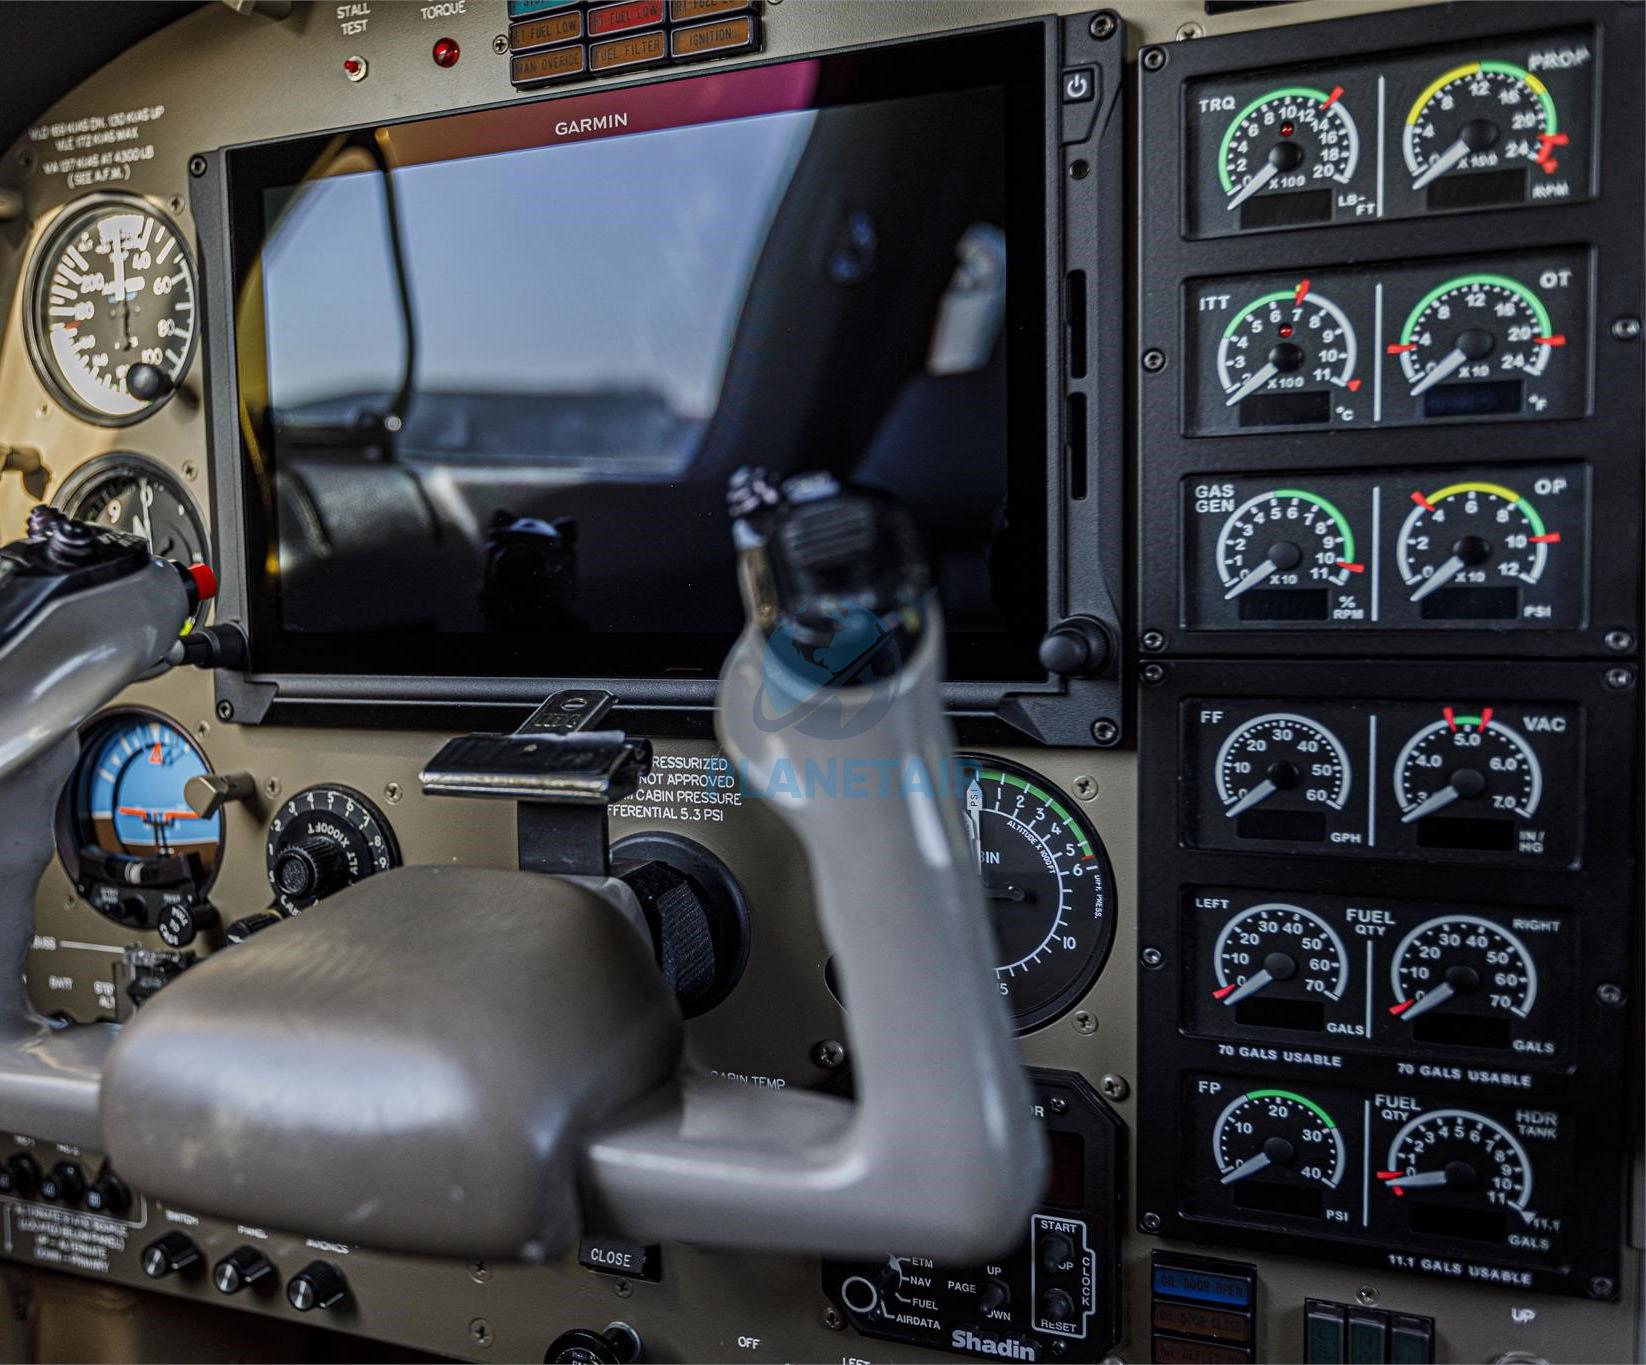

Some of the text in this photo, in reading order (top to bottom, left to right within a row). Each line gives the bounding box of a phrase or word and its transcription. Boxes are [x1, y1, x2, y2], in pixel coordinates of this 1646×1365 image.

[336, 3, 370, 19] STALL
[421, 1, 466, 20] TORQUE
[341, 20, 368, 35] TEST
[690, 28, 732, 46] IGNITION
[625, 39, 659, 56] FILTER
[1529, 45, 1590, 70] PROP
[1199, 97, 1236, 112] TRQ
[555, 113, 628, 136] GARMIN
[1264, 113, 1274, 125] 8
[1532, 182, 1569, 198] RPM
[1539, 270, 1571, 288] OT
[1200, 295, 1230, 311] ITT
[1465, 293, 1486, 307] 12
[1323, 330, 1334, 343] 9
[1508, 327, 1532, 341] 20
[1319, 350, 1337, 362] 10
[1502, 354, 1524, 369] 24
[1313, 368, 1331, 381] 11
[1195, 484, 1234, 498] GAS
[1534, 478, 1567, 494] OP
[1195, 500, 1234, 513] GEN
[1287, 507, 1298, 518] 6
[1304, 513, 1314, 525] 7
[1432, 509, 1445, 522] 4
[1496, 510, 1509, 522] 8
[1243, 524, 1253, 536] 3
[1323, 537, 1334, 549] 9
[1505, 535, 1526, 548] 10
[1316, 552, 1334, 564] 10
[1310, 568, 1329, 579] 11
[1498, 562, 1519, 575] 12
[1334, 609, 1363, 619] RPM
[1524, 606, 1551, 617] PSI
[1201, 711, 1223, 723] FF
[1523, 717, 1566, 732] VAC
[1272, 729, 1293, 741] 30
[1454, 733, 1481, 746] 5.0
[1247, 740, 1267, 751] 20
[1298, 741, 1318, 752] 40
[653, 756, 727, 770] RESSURIZED
[1416, 755, 1442, 767] 4.0
[1490, 758, 1517, 770] 6.0
[1234, 762, 1250, 773] 10
[1312, 765, 1332, 776] 50
[639, 773, 734, 788] NOT APPROVED
[307, 793, 313, 803] 4
[328, 792, 334, 803] 5
[636, 789, 673, 802] CABIN
[677, 791, 742, 805] PRESSURE
[1016, 795, 1024, 807] 2
[1306, 790, 1327, 801] 60
[289, 801, 295, 814] 3
[346, 799, 353, 811] 6
[1492, 796, 1516, 808] 7.0
[363, 809, 370, 826] 7
[608, 805, 723, 821] FFERENTIAL 5.3 PSI
[1035, 808, 1045, 820] 3
[274, 820, 281, 831] 2
[1051, 823, 1062, 835] 4
[1006, 820, 1038, 845] ALTITUDE
[1331, 833, 1361, 843] GPH
[374, 836, 381, 847] 8
[1519, 842, 1543, 852] HG
[1066, 844, 1075, 857] 5
[1073, 864, 1083, 876] 6
[1195, 898, 1229, 909] LEFT
[1346, 909, 1396, 924] FUEL
[1258, 921, 1279, 933] 30
[1282, 922, 1303, 934] 40
[1355, 925, 1386, 936] QTY
[1513, 918, 1560, 932] RIGHT
[1064, 937, 1076, 949] 10
[1240, 933, 1259, 945] 20
[1302, 938, 1322, 950] 50
[1439, 934, 1460, 946] 30
[1466, 936, 1488, 948] 40
[1232, 953, 1249, 964] 10
[1420, 947, 1441, 959] 20
[1486, 952, 1508, 964] 50
[1310, 959, 1330, 970] 60
[1410, 968, 1429, 979] 10
[1305, 979, 1324, 991] 70
[1495, 974, 1517, 986] 60
[1490, 995, 1511, 1008] 70
[1327, 1022, 1364, 1035] GALS
[1512, 1040, 1555, 1053] GALS
[1218, 1044, 1342, 1067] 70 GALS USABLE
[1398, 1063, 1532, 1087] 70 GALS USABLE
[1199, 1081, 1221, 1094] FP
[1375, 1094, 1421, 1111] FUEL
[1268, 1106, 1288, 1117] 20
[1382, 1111, 1408, 1121] QTY
[1516, 1110, 1558, 1126] HDR
[1235, 1122, 1252, 1134] 10
[1454, 1126, 1464, 1138] 5
[1519, 1126, 1557, 1138] TANK
[1302, 1129, 1322, 1142] 30
[1495, 1151, 1505, 1162] 8
[1301, 1167, 1321, 1179] 40
[1492, 1178, 1512, 1190] 10
[1487, 1191, 1506, 1204] 11
[1326, 1209, 1348, 1222] PSI
[1041, 1221, 1077, 1233] START
[1508, 1235, 1550, 1249] GALS
[590, 1249, 631, 1267] CLOSE
[913, 1257, 933, 1268] ETM
[987, 1266, 1001, 1276] UP
[1388, 1254, 1532, 1285] 11.1 GALS USABLE
[910, 1276, 931, 1288] NAV
[948, 1281, 976, 1293] PAGE
[1082, 1257, 1090, 1306] CLOCK
[913, 1297, 939, 1310] FUEL
[1512, 1308, 1536, 1323] UP
[896, 1314, 940, 1330] AIRDATA
[1041, 1319, 1076, 1333] RESET
[738, 1336, 760, 1350] OFF
[952, 1330, 1036, 1361] Shadin
